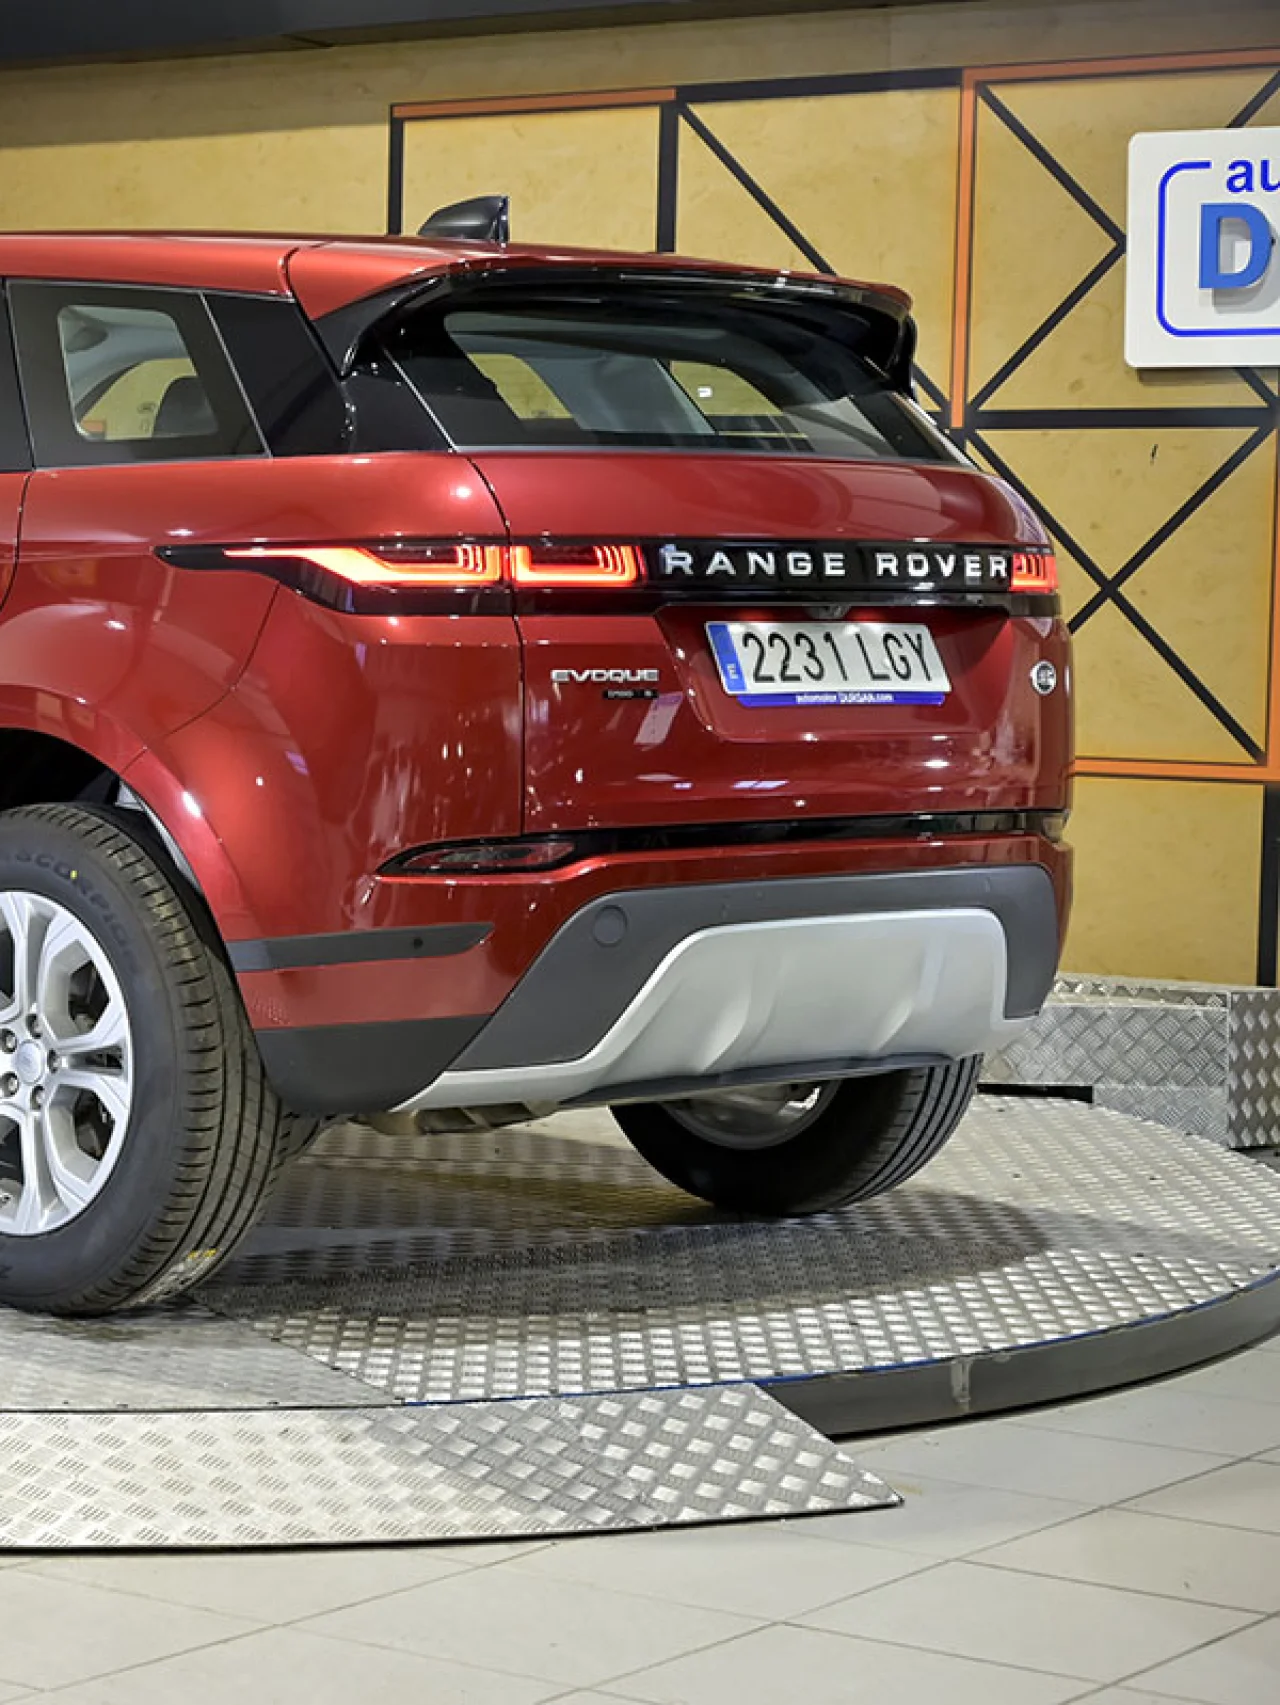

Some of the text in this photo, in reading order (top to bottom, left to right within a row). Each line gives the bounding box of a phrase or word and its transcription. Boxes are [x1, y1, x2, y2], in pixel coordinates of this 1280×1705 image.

[662, 550, 1009, 578] RANGE ROVER
[742, 631, 933, 683] 2231 LGY
[550, 668, 660, 683] EVOQUE
